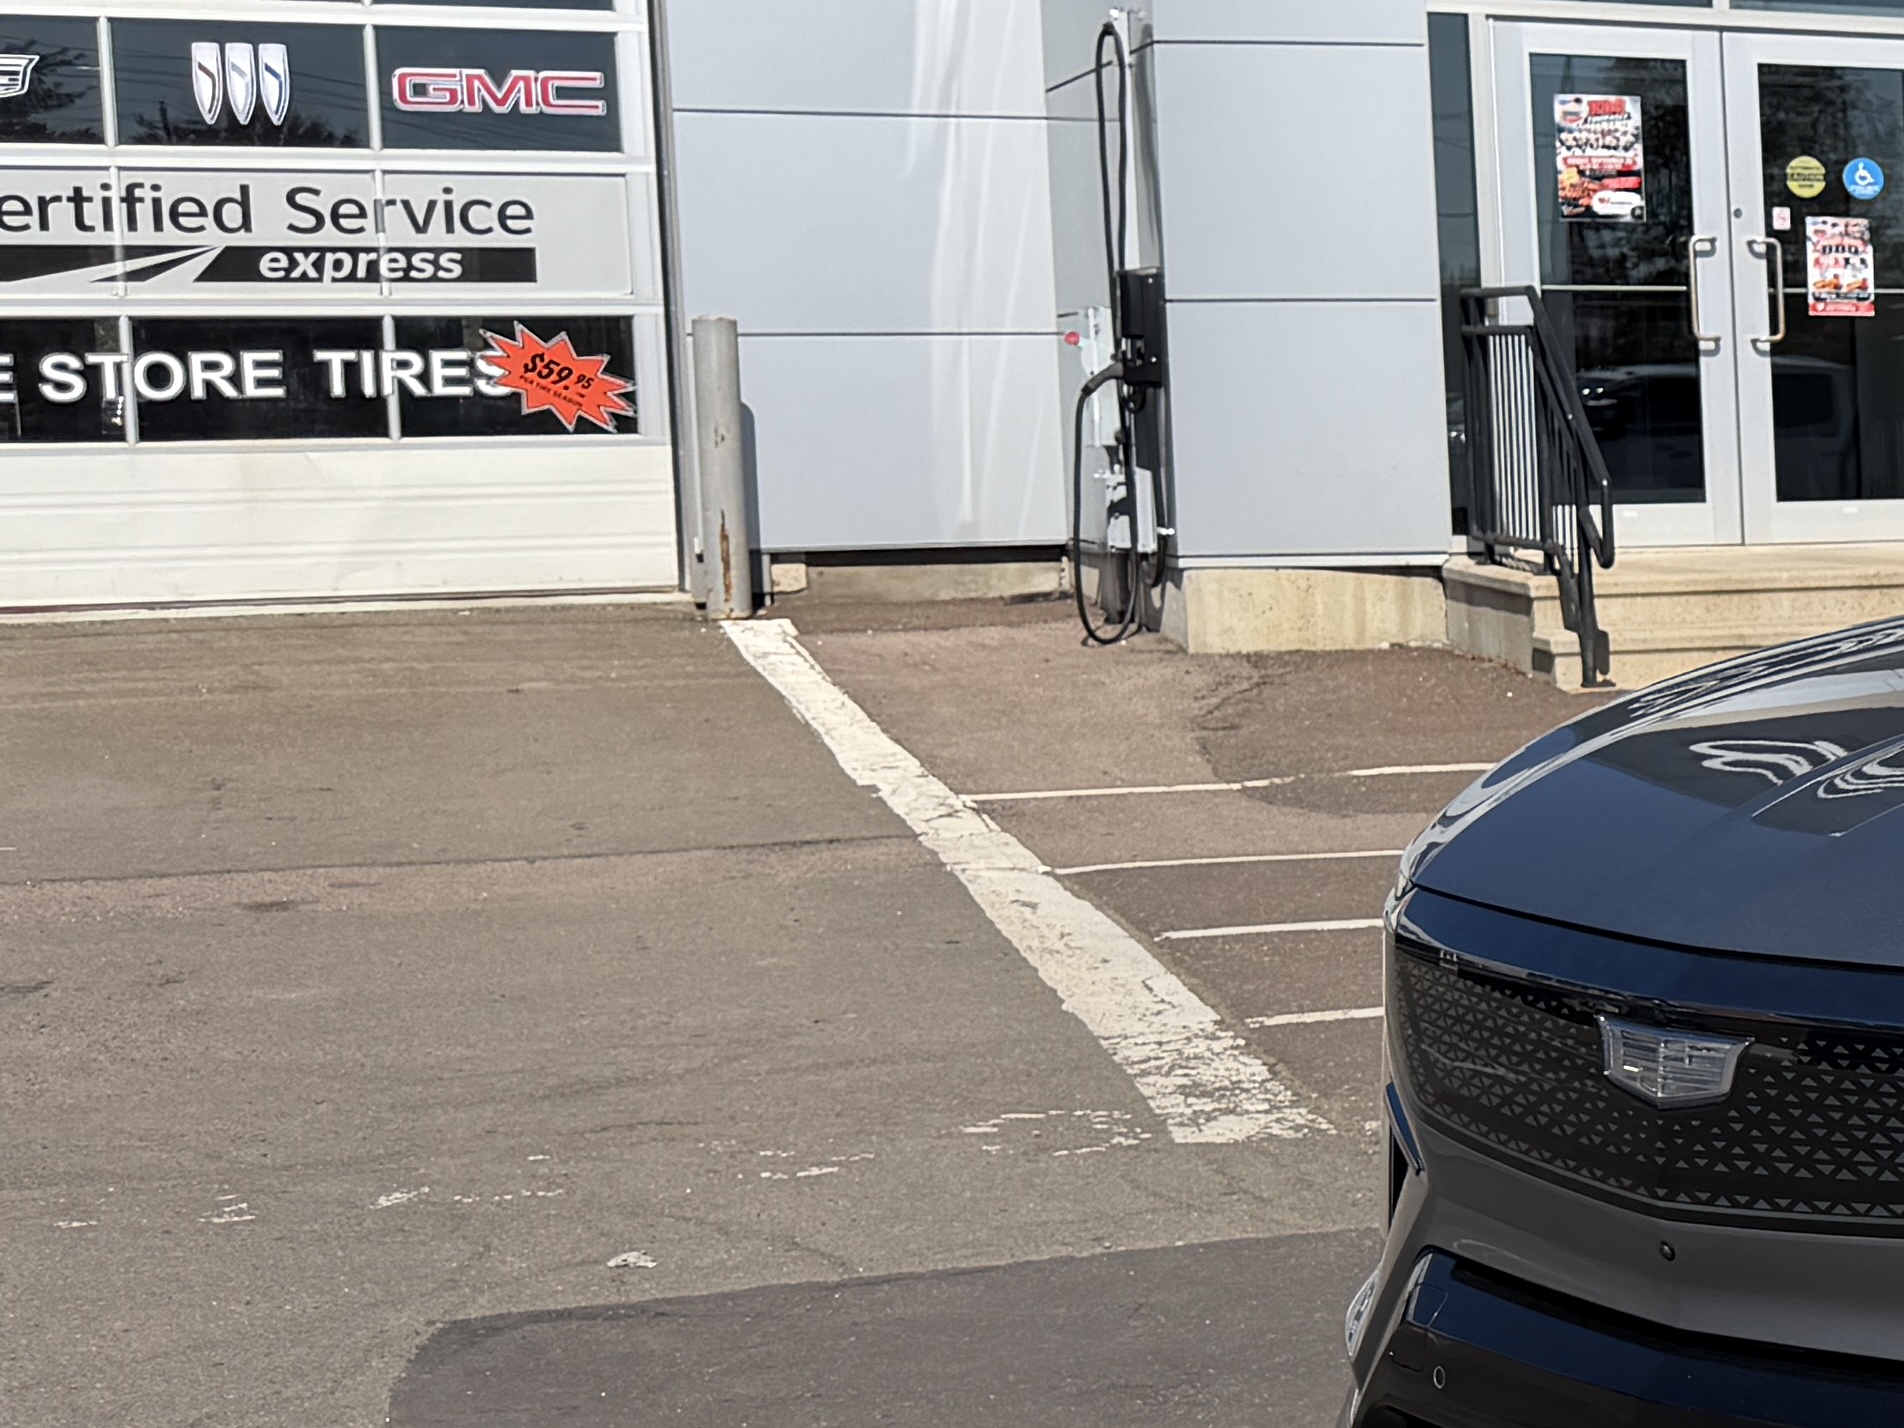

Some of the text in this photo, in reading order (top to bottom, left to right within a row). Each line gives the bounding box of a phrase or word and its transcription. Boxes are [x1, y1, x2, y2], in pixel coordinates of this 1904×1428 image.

[392, 68, 606, 115] GMC
[284, 186, 535, 235] Service
[259, 247, 463, 283] express
[38, 349, 287, 403] STORE
